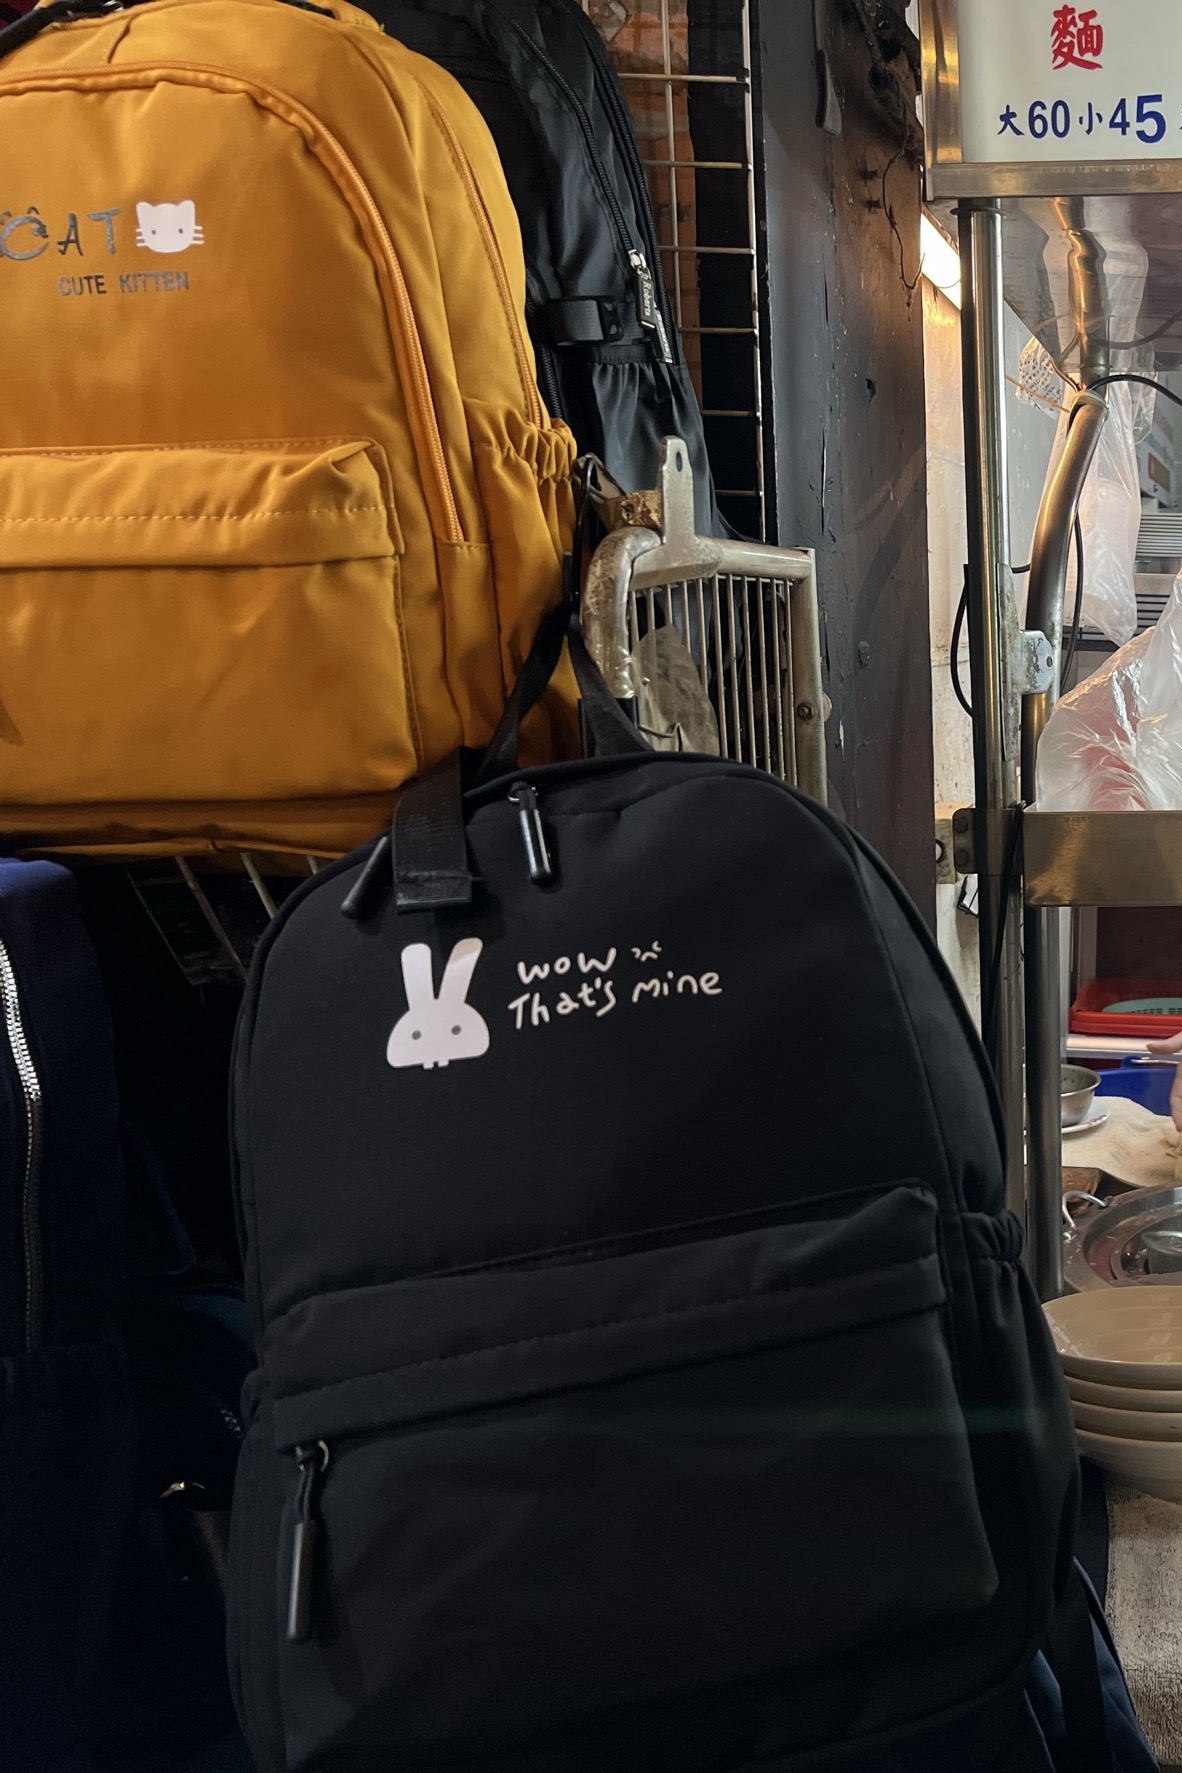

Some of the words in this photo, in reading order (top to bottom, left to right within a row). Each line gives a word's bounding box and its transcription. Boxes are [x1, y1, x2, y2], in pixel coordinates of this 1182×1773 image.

[1050, 4, 1104, 70] 麵
[57, 274, 107, 296] CUTE
[119, 271, 190, 293] KITTEN
[508, 977, 616, 1029] That's
[632, 971, 722, 1003] mine
